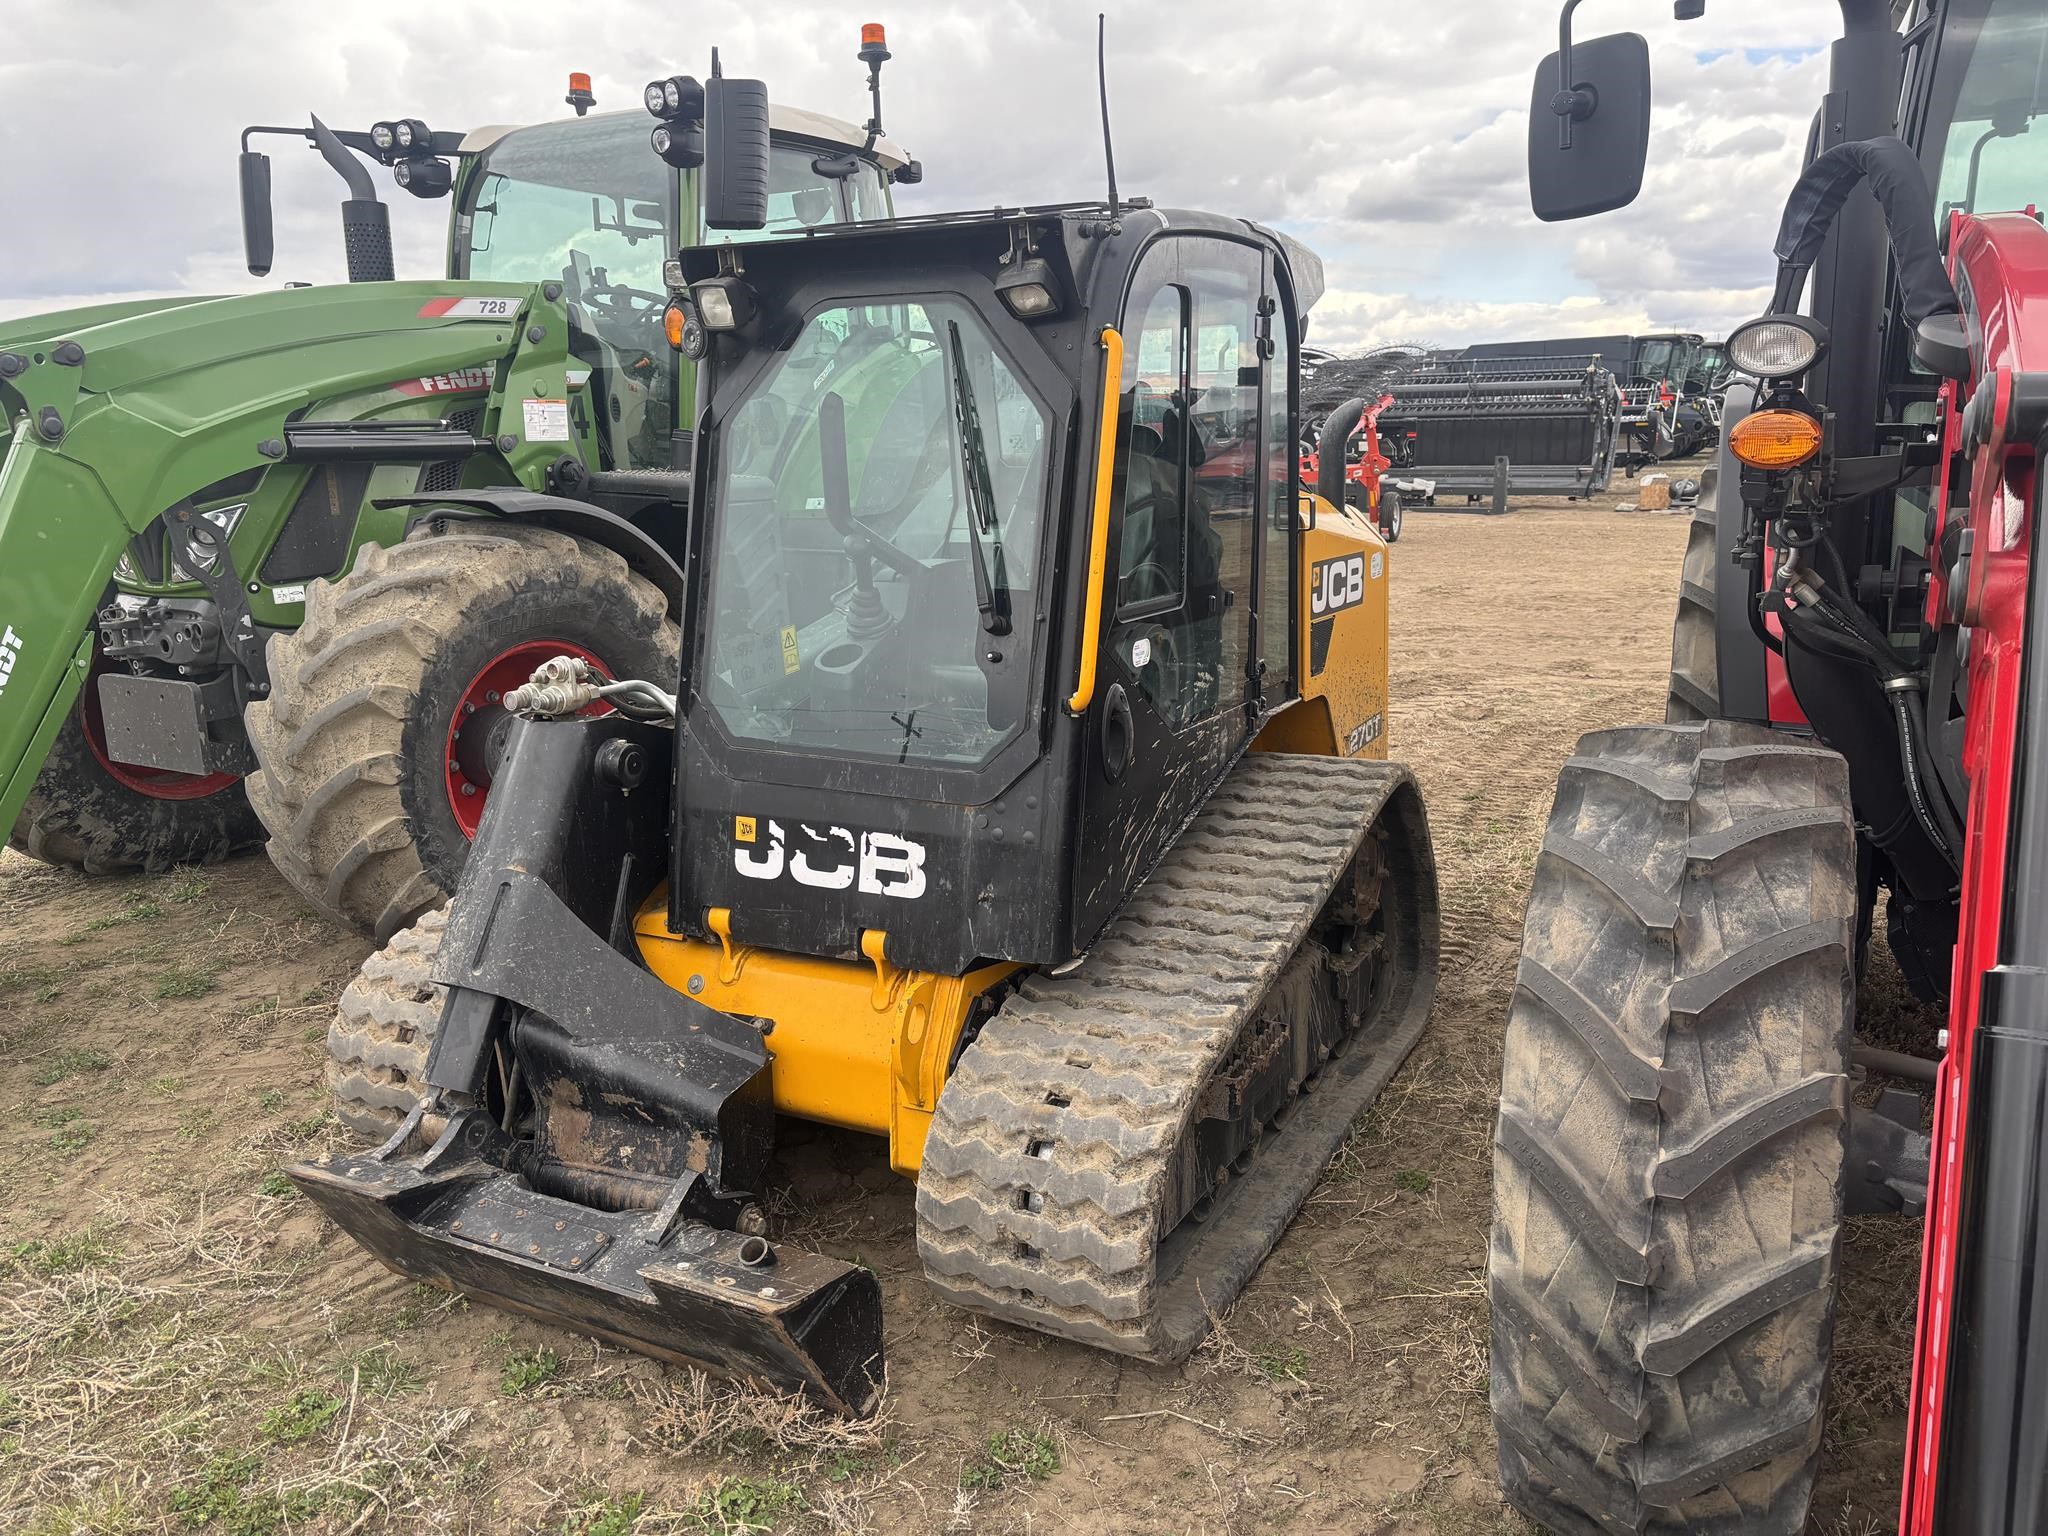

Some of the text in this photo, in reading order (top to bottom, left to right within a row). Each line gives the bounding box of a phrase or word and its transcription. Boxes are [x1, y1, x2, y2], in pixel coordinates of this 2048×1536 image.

[479, 301, 506, 314] 728
[419, 366, 496, 392] FENDT
[1312, 557, 1364, 614] JCB
[734, 819, 927, 899] JCB
